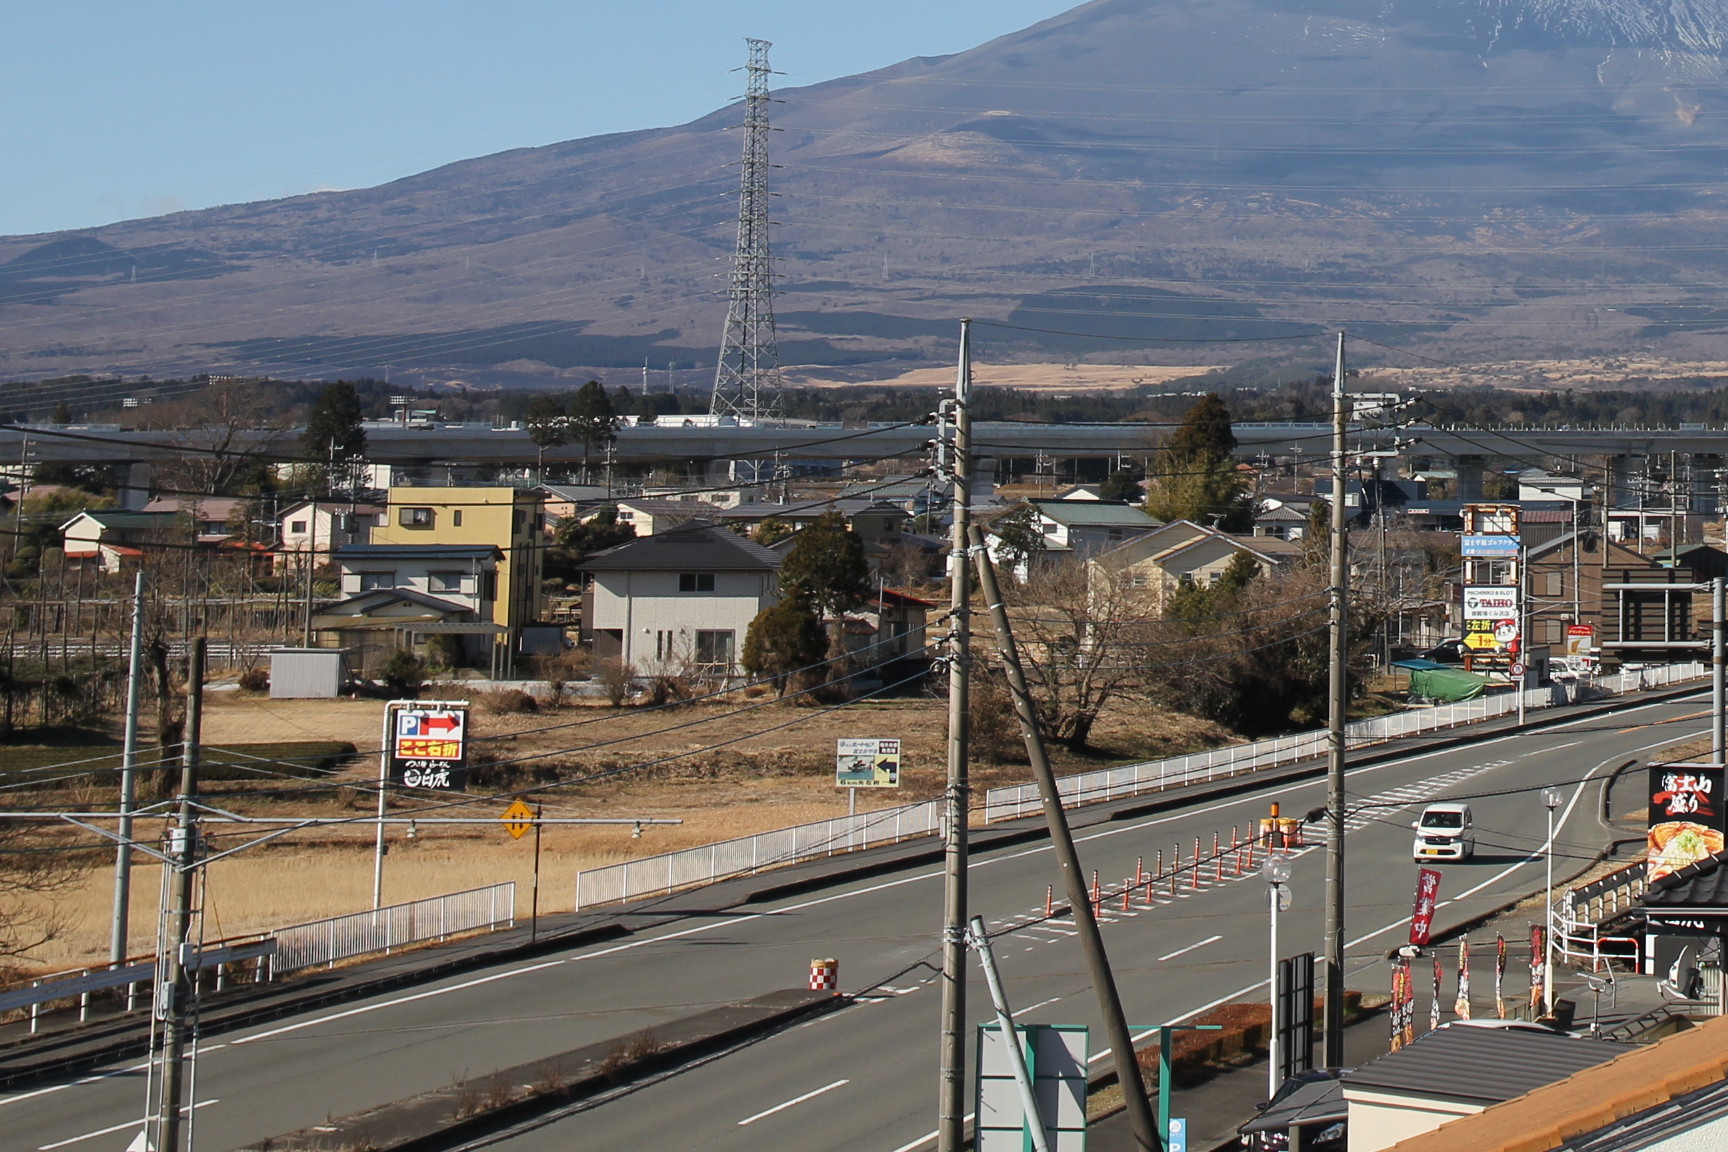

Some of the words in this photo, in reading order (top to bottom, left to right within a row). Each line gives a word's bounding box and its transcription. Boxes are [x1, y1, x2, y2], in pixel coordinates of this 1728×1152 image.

[1480, 599, 1514, 608] TAIHO
[1478, 635, 1491, 647] 1分
[401, 716, 417, 735] P
[400, 741, 458, 757] ここ右折
[421, 768, 450, 789] 白虎
[1662, 772, 1712, 794] 富士山
[1668, 793, 1698, 814] 盛り
[1414, 873, 1436, 939] 営業中
